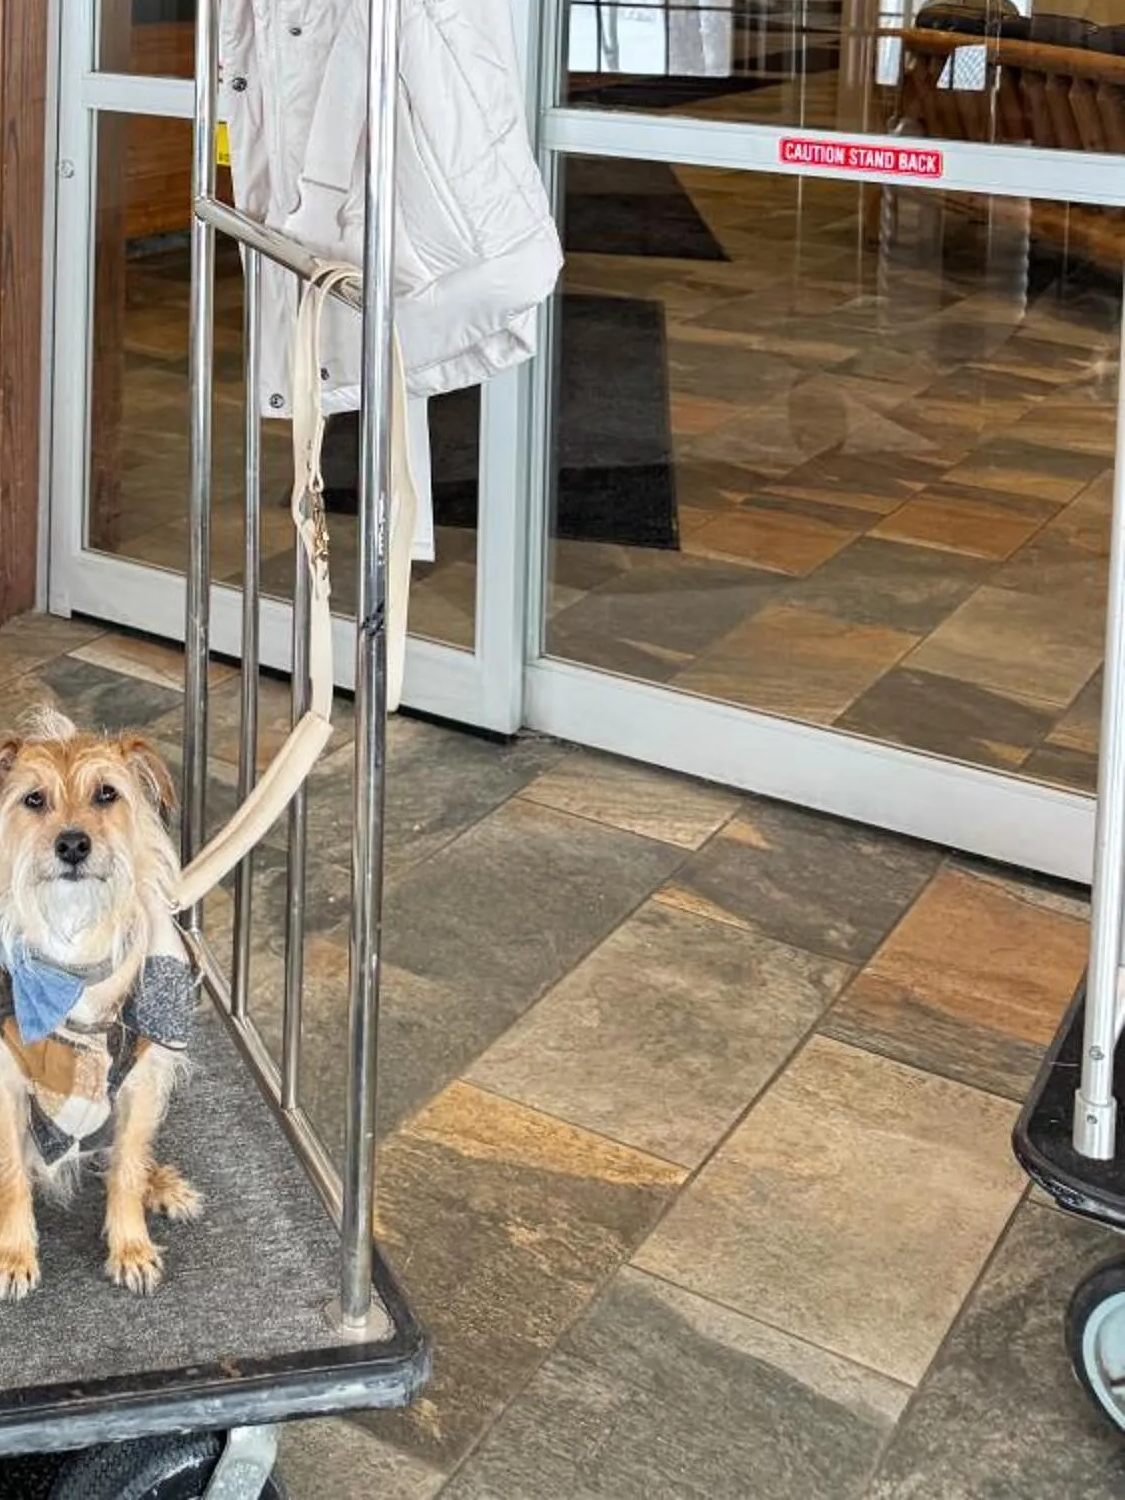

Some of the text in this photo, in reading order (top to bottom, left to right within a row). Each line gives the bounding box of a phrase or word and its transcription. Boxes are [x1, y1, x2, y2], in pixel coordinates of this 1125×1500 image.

[785, 142, 938, 173] CAUTION STAND BACK
